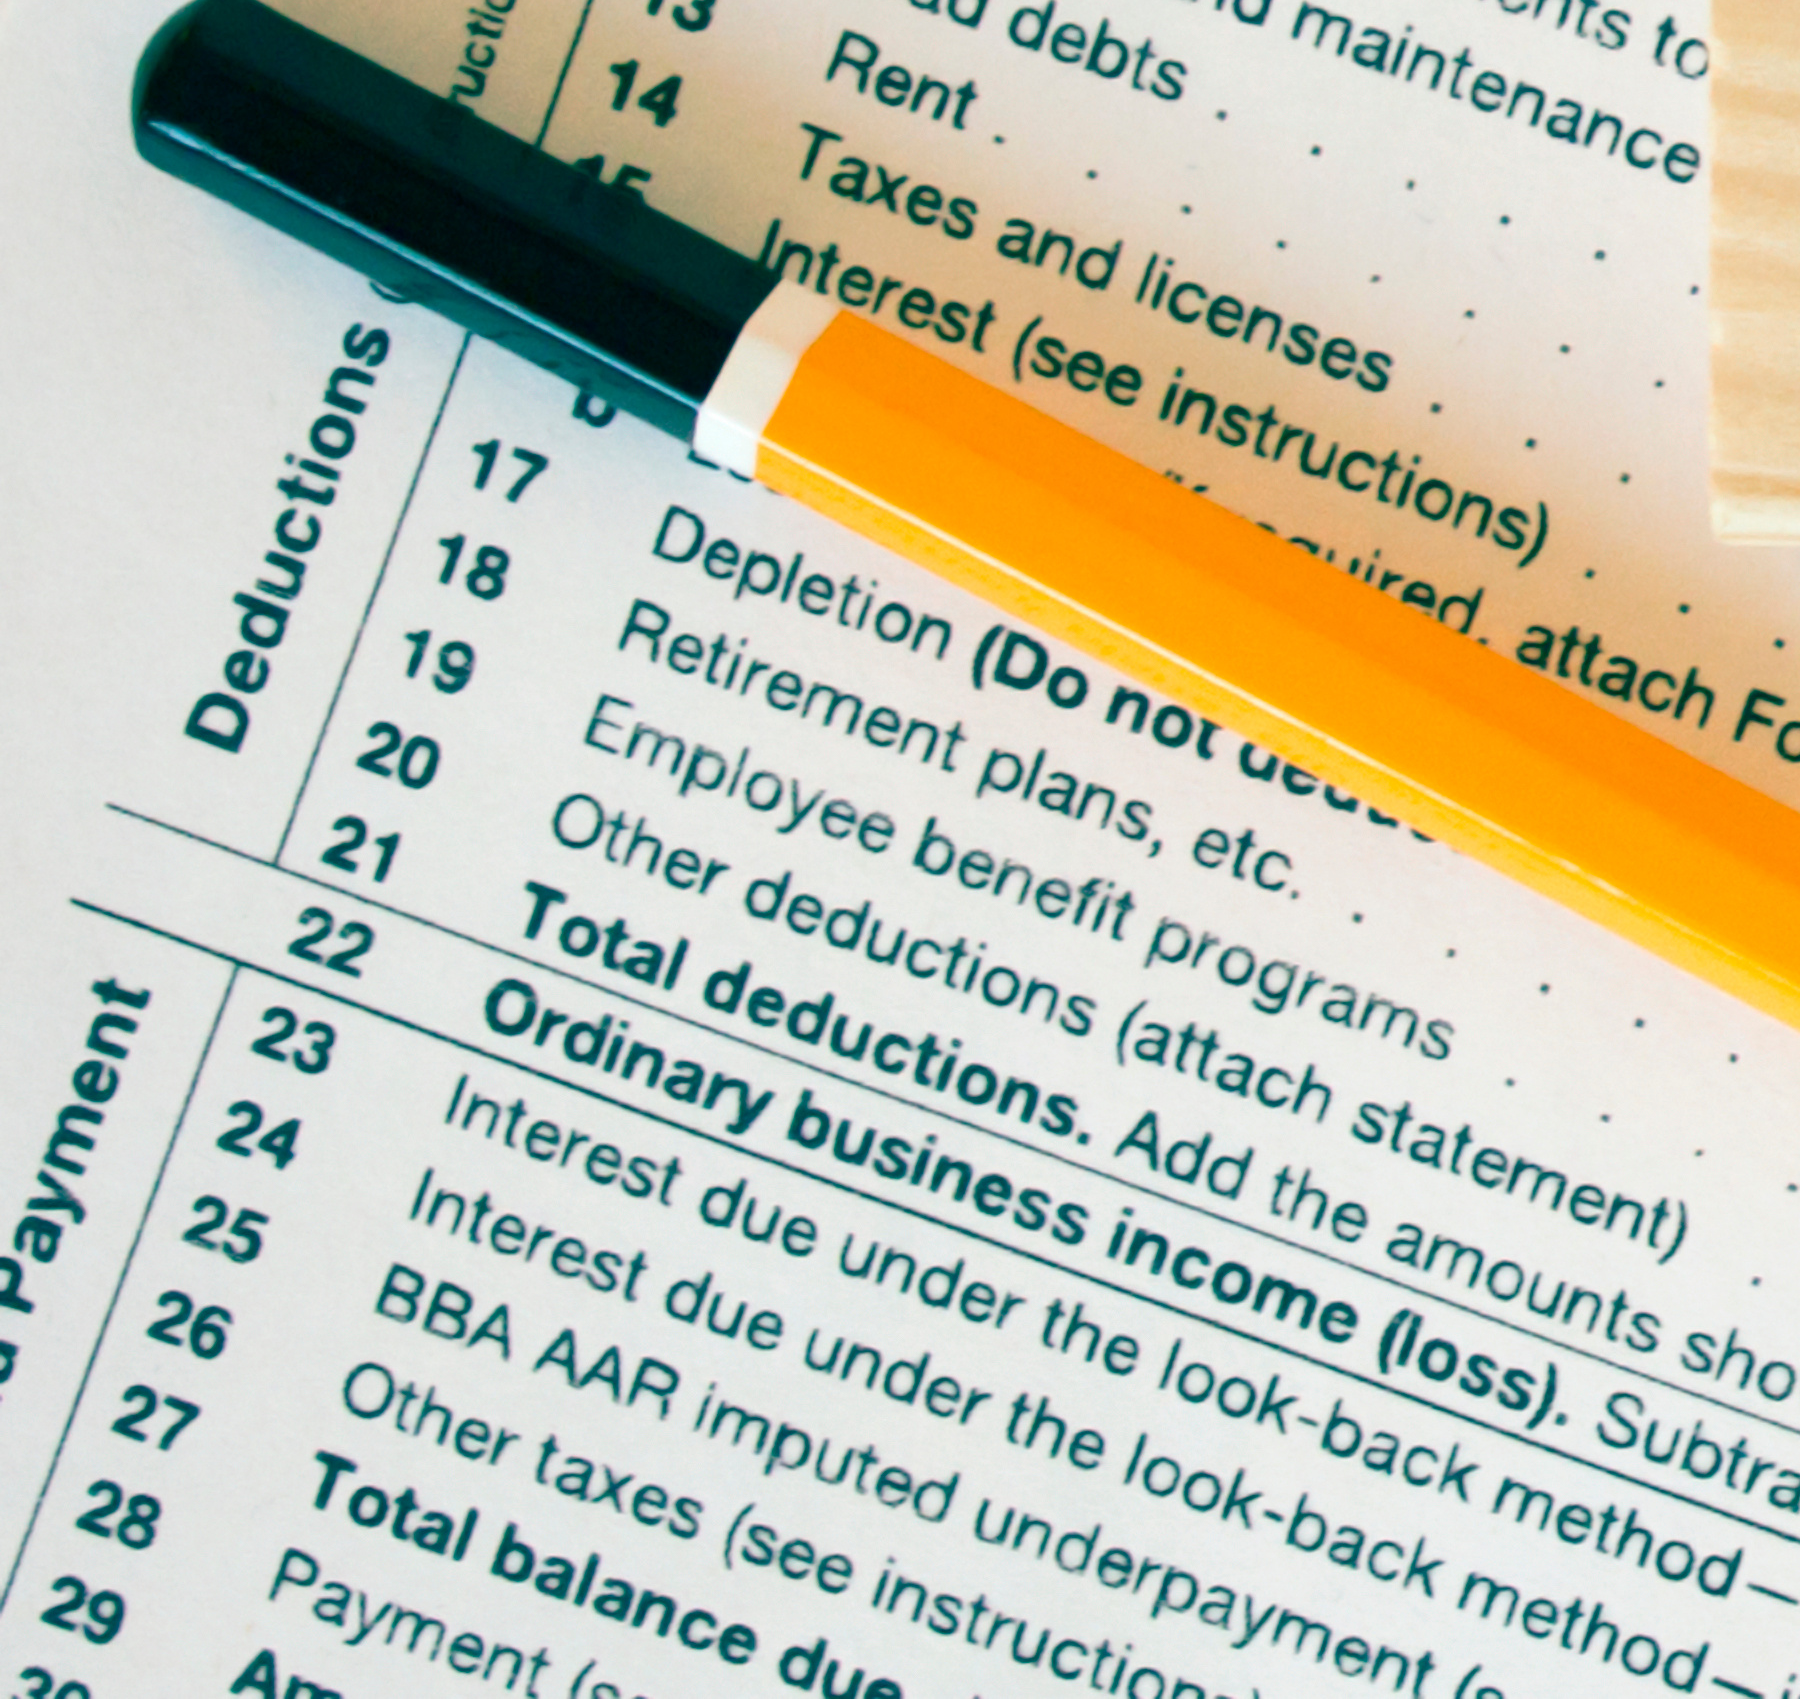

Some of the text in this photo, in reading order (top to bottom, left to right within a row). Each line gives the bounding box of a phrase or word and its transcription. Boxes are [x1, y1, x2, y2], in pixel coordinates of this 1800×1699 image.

[607, 57, 1395, 395] 14 Taxes and licenses
[181, 321, 392, 756] Deductions
[436, 532, 512, 603] 18
[616, 596, 967, 775] Retirement
[974, 747, 1164, 860] plans,
[1190, 826, 1300, 901] etc.
[1514, 623, 1717, 731] attach
[318, 813, 402, 885] 21
[522, 879, 691, 993] Total
[701, 960, 1092, 1147] deductions.
[1112, 1109, 1256, 1202] Add
[1269, 1164, 1370, 1245] the
[1384, 1221, 1663, 1355] amounts
[353, 719, 1689, 1267] 20 Other deductions (attach statement)
[248, 1004, 1481, 1504] 23 Interest due under the look-back
